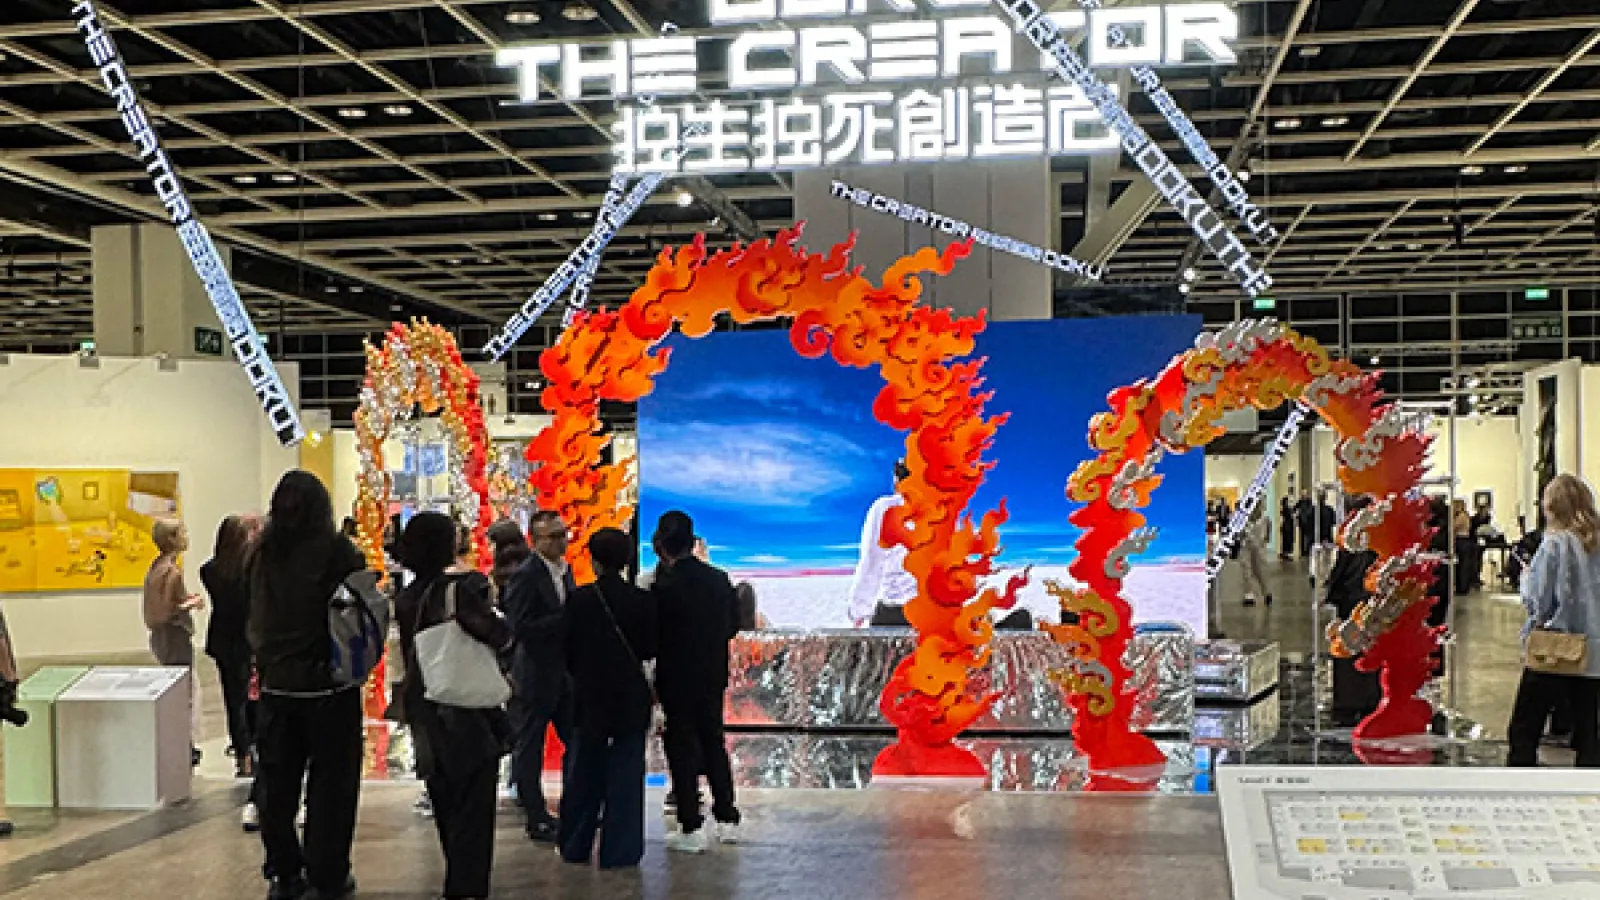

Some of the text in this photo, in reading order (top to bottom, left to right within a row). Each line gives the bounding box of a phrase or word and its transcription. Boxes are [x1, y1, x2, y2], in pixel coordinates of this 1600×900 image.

[495, 38, 697, 102] THE
[728, 4, 1238, 88] CREATOR
[72, 0, 115, 65] THE
[101, 61, 190, 222] CREATOR
[1135, 142, 1225, 240] DOKU
